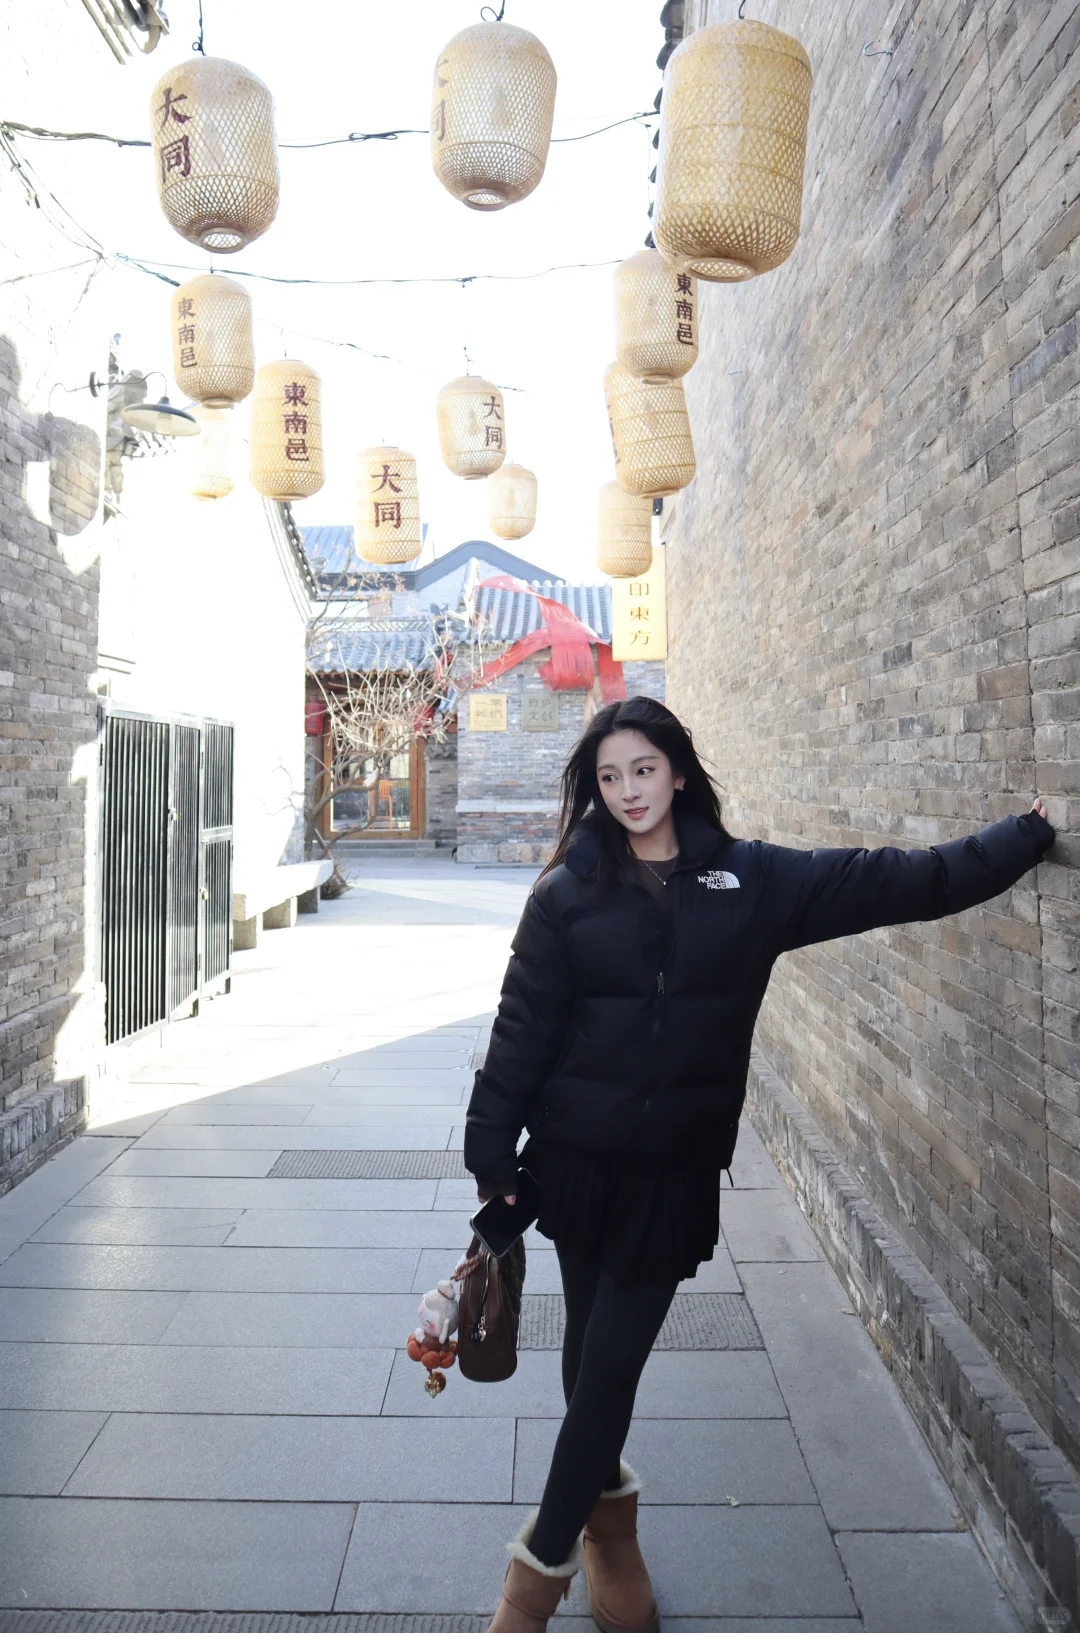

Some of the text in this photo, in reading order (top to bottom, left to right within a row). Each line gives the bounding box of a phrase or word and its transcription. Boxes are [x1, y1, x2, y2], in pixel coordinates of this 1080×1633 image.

[156, 87, 192, 184] 大同
[177, 298, 198, 369] 東南邑
[674, 272, 694, 346] 東南邑
[282, 382, 309, 462] 東南邑
[482, 395, 503, 450] 大同
[371, 464, 403, 529] 大同
